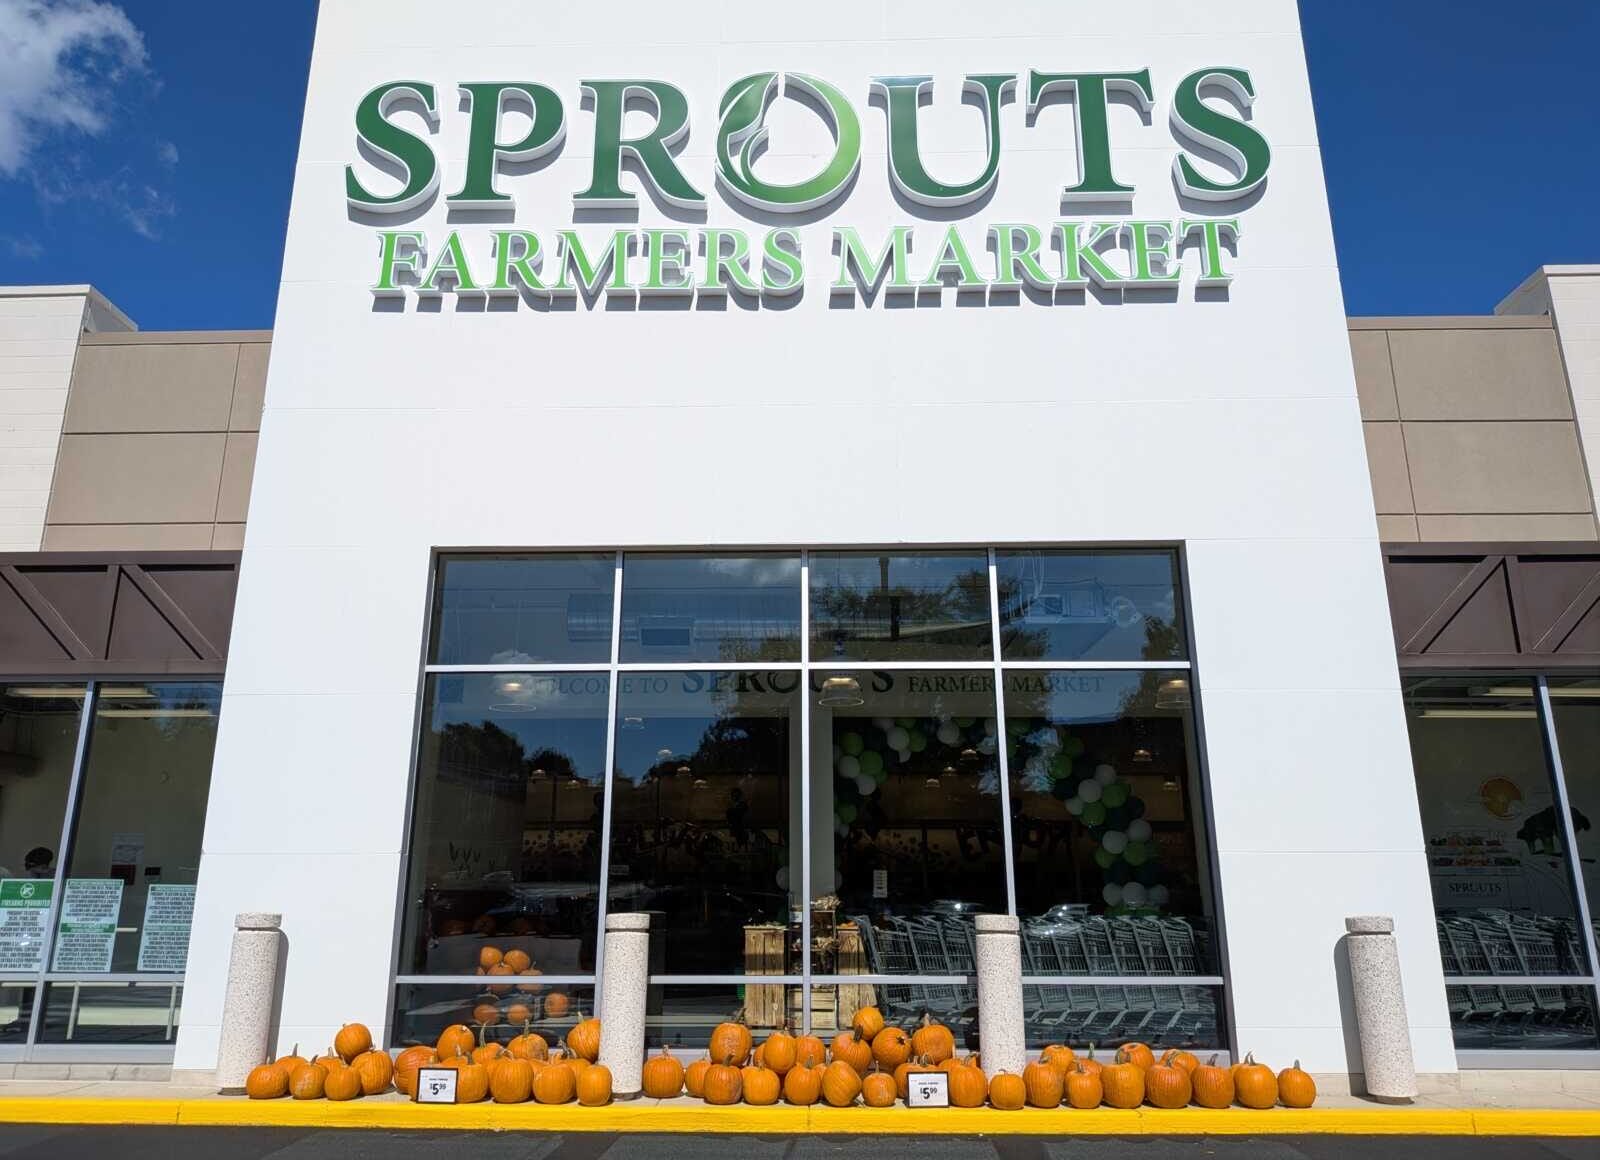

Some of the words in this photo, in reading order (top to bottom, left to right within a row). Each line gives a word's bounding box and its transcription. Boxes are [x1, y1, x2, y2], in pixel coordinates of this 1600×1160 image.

[344, 65, 1273, 216] SPROUTS
[370, 226, 806, 298] FARMERS
[828, 217, 1240, 296] MARKET
[640, 677, 669, 695] TO
[908, 675, 1005, 694] FARMER
[1011, 674, 1104, 694] MARKET
